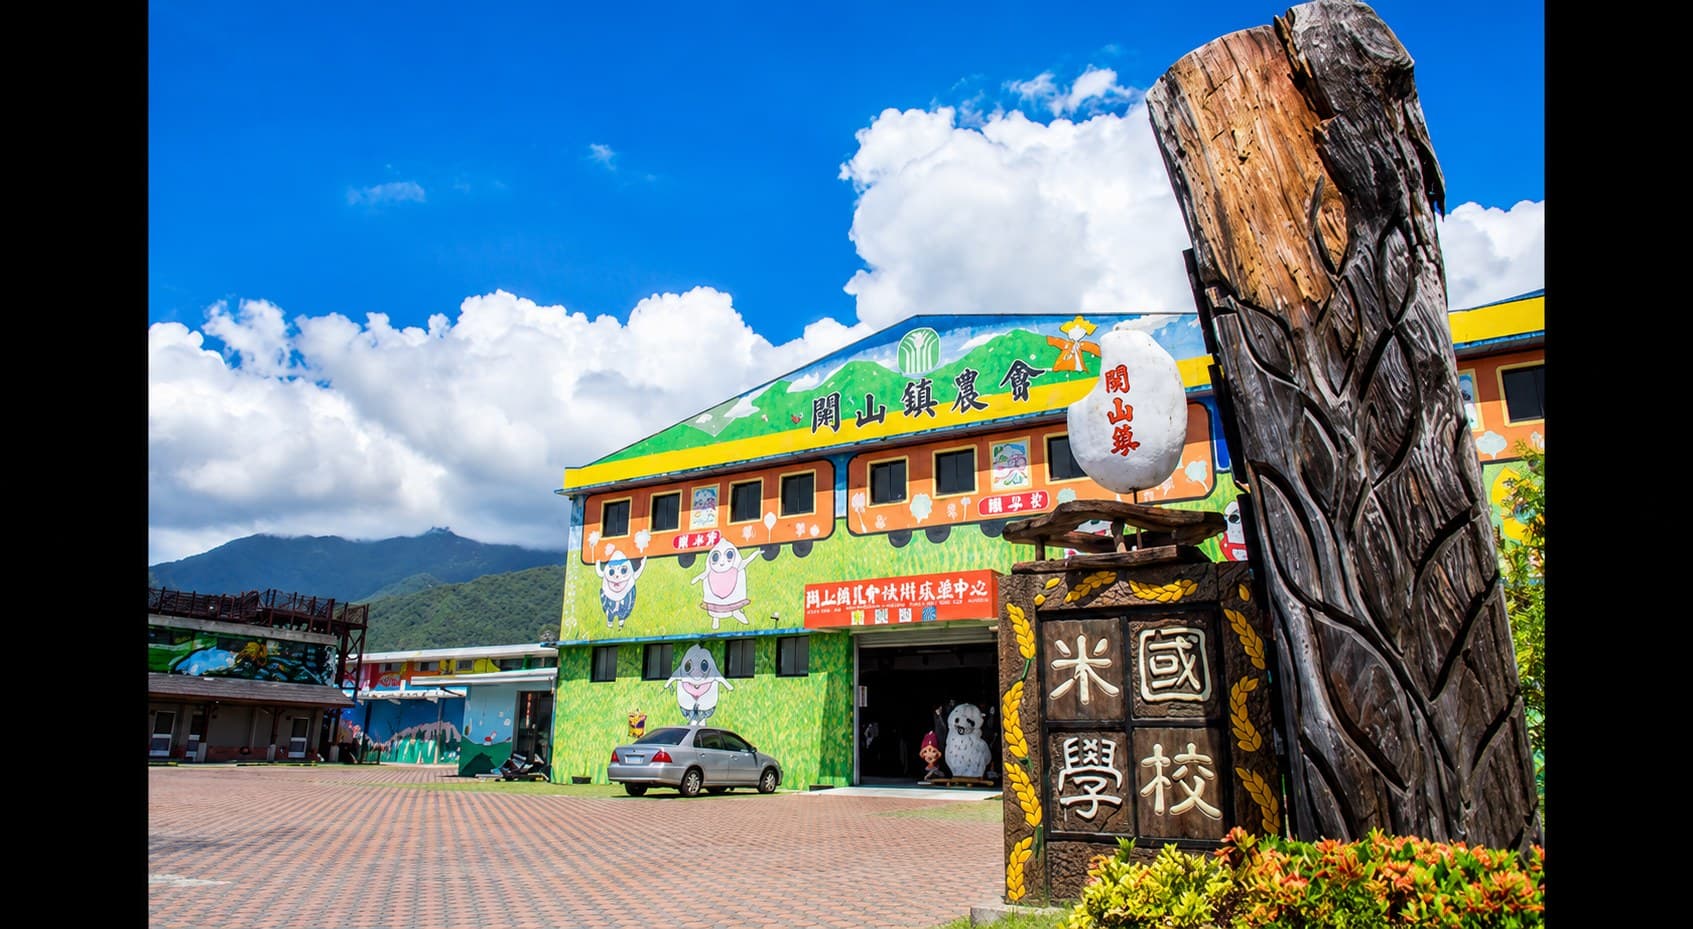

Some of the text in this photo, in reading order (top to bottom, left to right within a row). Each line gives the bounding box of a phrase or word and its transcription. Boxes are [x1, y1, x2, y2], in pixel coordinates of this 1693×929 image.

[1104, 364, 1141, 457] 關山鎮
[1050, 627, 1212, 705] 米國
[1058, 737, 1223, 820] 學校
